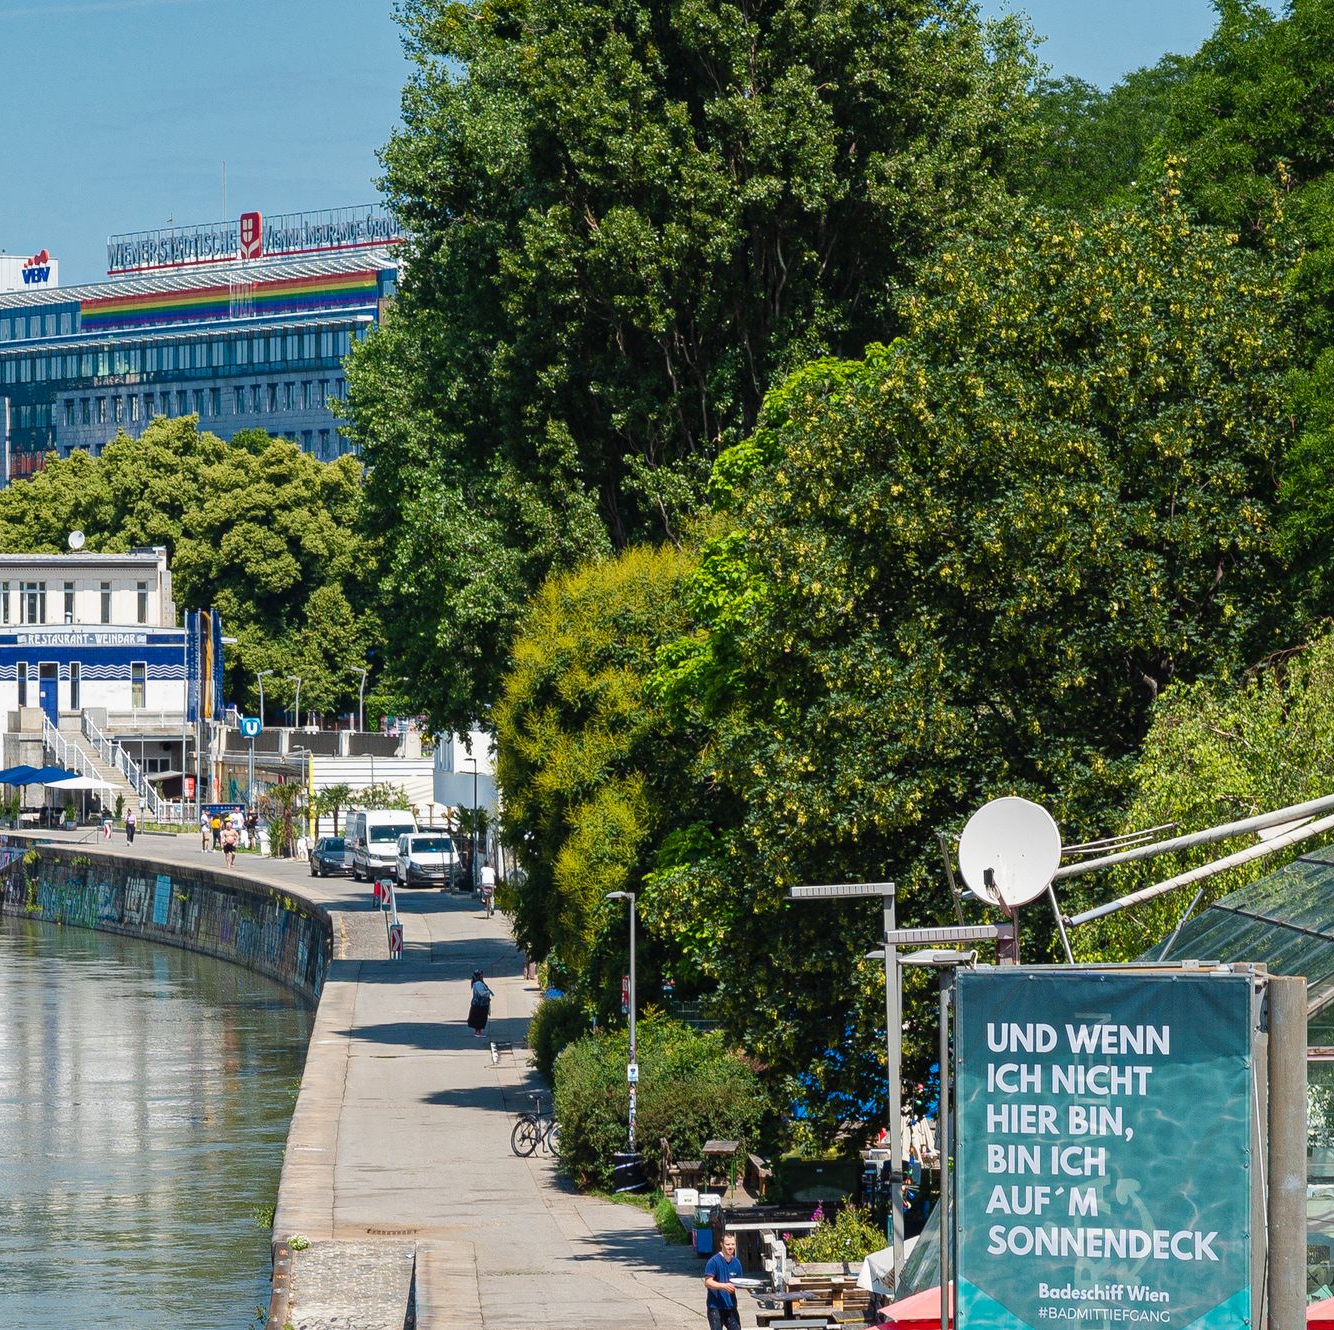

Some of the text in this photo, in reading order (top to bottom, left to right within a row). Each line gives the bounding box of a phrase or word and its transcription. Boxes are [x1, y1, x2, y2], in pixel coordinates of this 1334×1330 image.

[107, 239, 157, 270] WIENER
[22, 267, 50, 284] VBV
[95, 634, 136, 644] WEINBAR
[246, 722, 258, 734] U
[986, 1022, 1171, 1056] UND WENN
[987, 1063, 1153, 1096] ICH NICHT
[986, 1103, 1134, 1142] HIER BIN,
[986, 1144, 1106, 1176] BIN ICH
[986, 1224, 1220, 1262] SONNENDECK
[1038, 1283, 1170, 1303] Badeschiff Wien
[1038, 1307, 1171, 1323] #BADMITTIEFGANG
